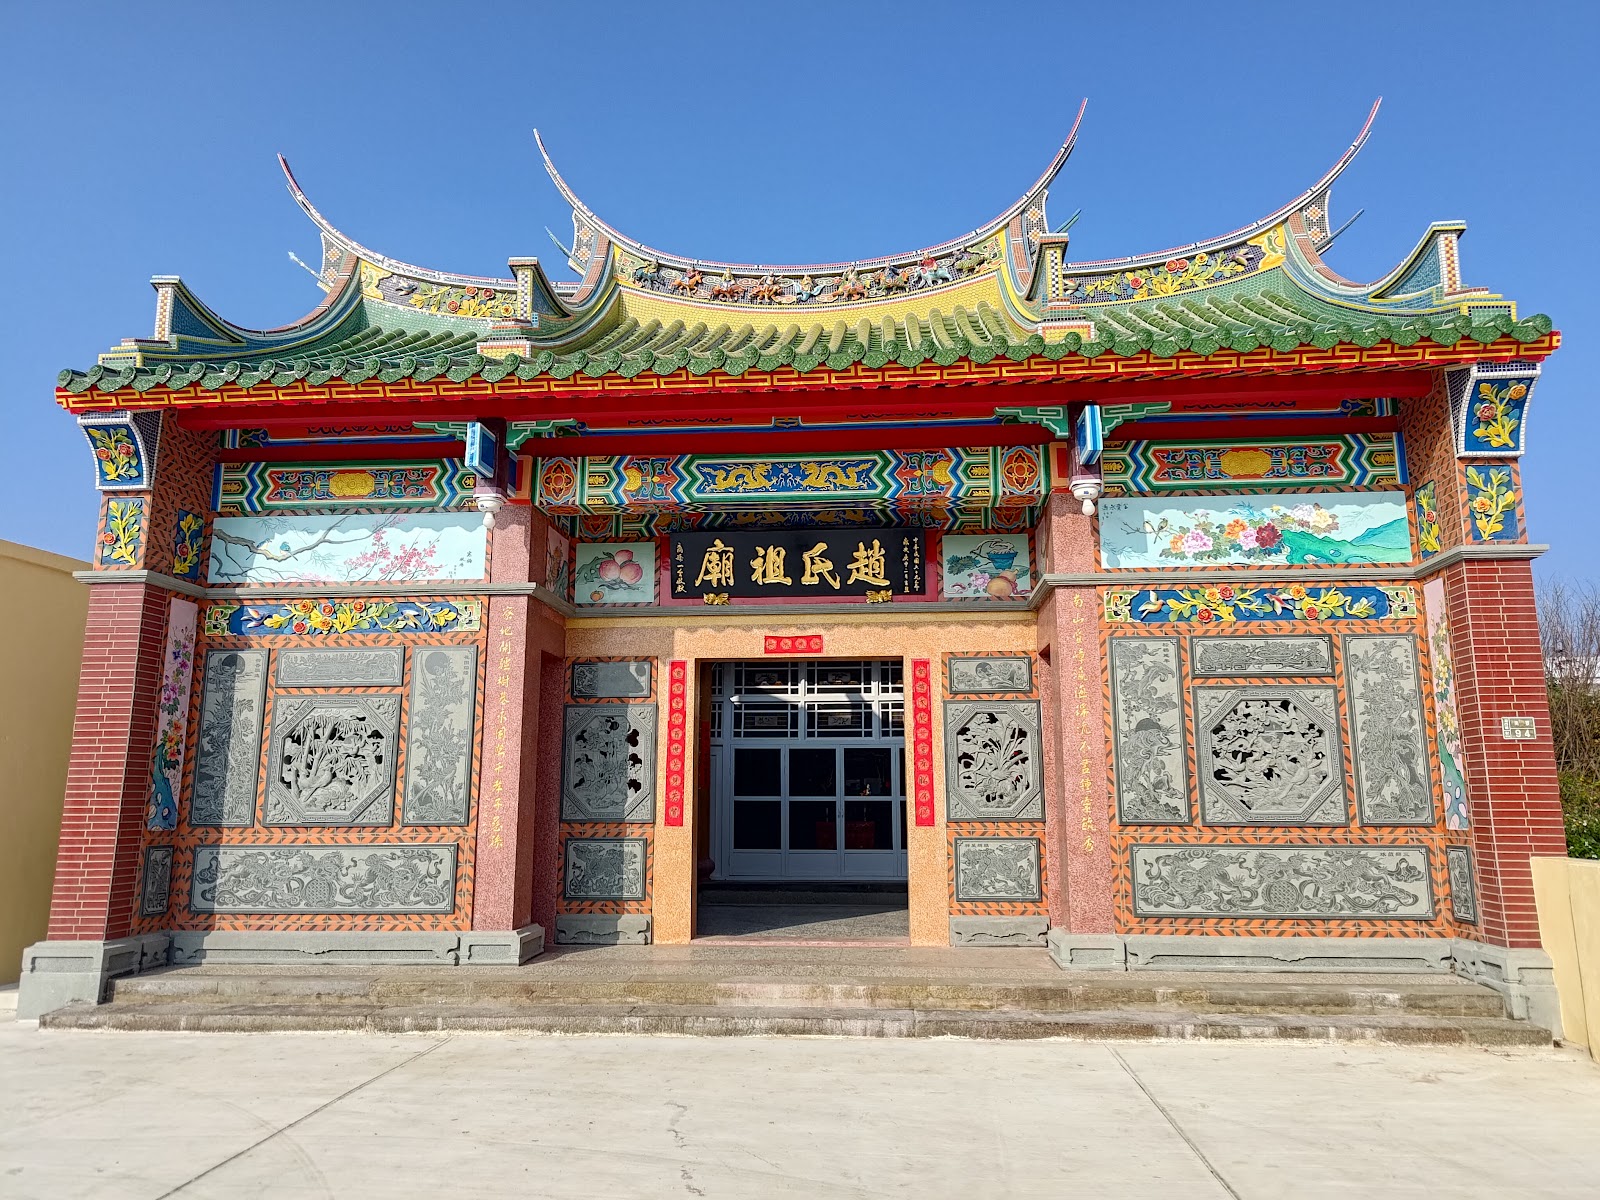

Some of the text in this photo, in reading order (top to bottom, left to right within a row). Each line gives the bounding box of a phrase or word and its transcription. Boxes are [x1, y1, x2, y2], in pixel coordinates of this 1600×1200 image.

[694, 538, 891, 590] 趙氏祖廟
[1514, 729, 1531, 738] 94
